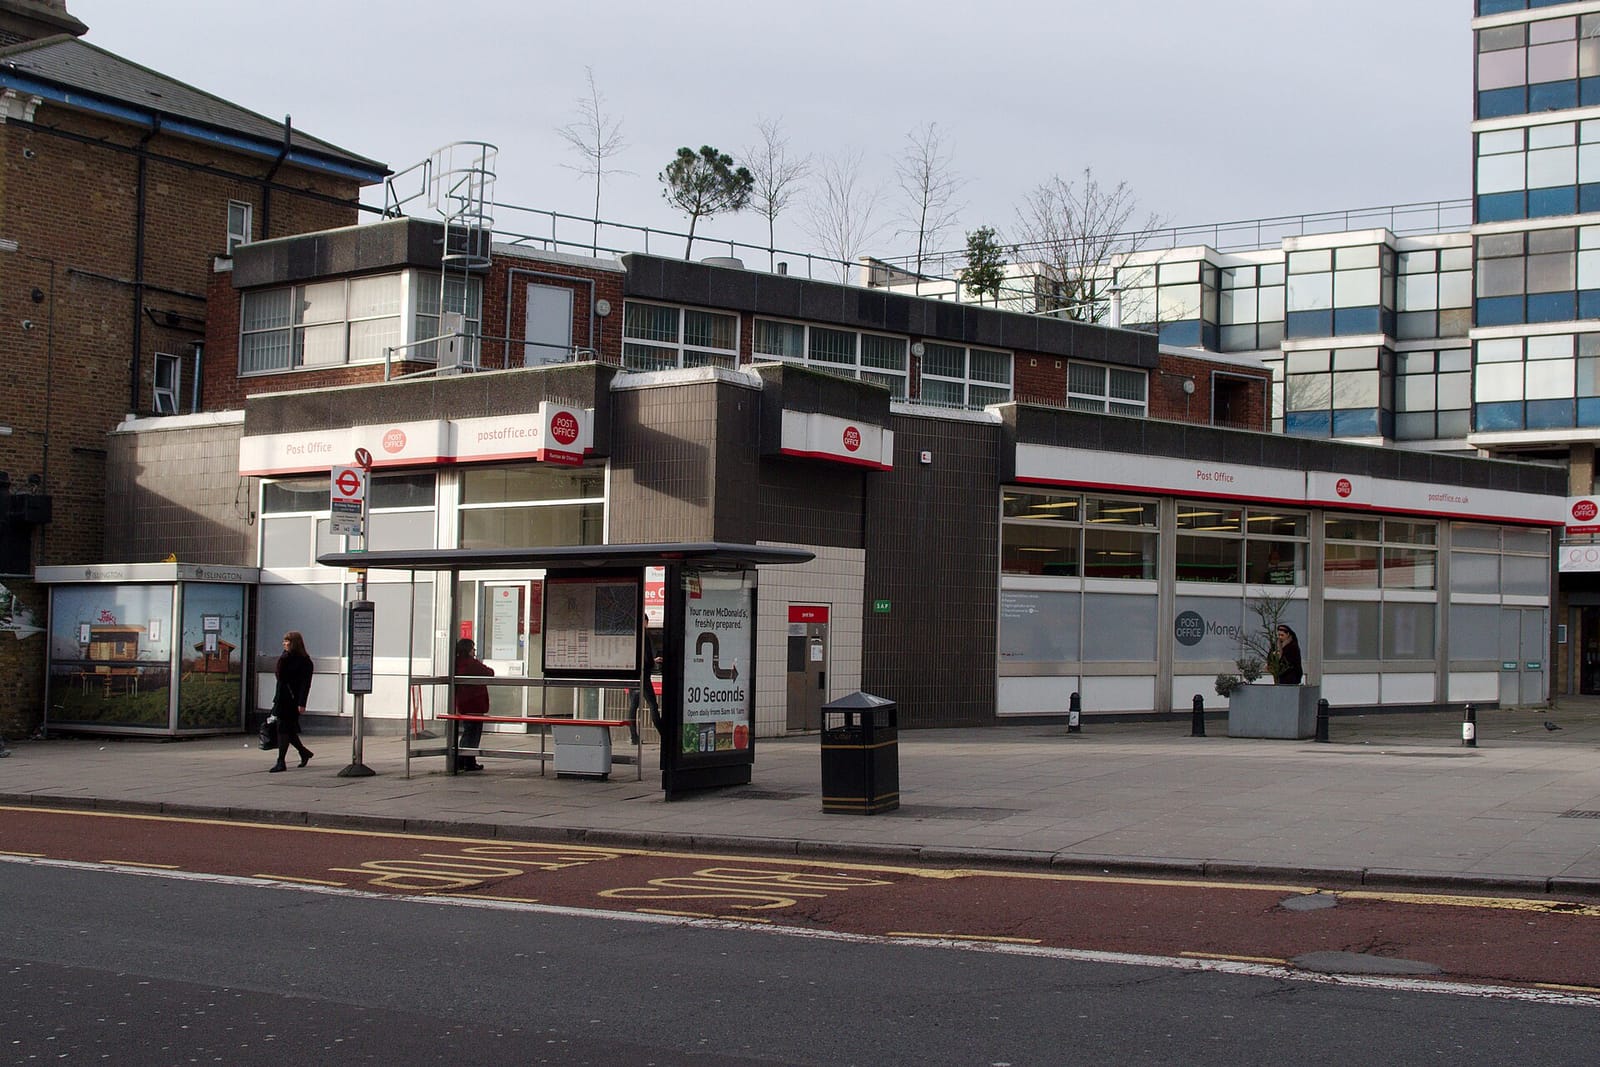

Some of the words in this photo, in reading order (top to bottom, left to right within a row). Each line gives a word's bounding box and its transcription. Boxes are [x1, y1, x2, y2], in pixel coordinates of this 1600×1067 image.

[556, 418, 574, 428] POST
[552, 427, 576, 438] OFFICE
[384, 440, 404, 448] OFFICE
[844, 438, 859, 446] OFFICE
[286, 444, 304, 455] Post
[308, 442, 332, 453] Office
[358, 450, 368, 464] V
[1197, 470, 1212, 480] Post
[1214, 472, 1234, 483] Office
[1428, 493, 1469, 504] postoffice.co.uk
[91, 570, 123, 578] ISLINGTON
[204, 572, 242, 580] ISLINGTON
[689, 606, 702, 616] Your
[695, 619, 714, 630] freshly
[1180, 618, 1199, 627] POST
[1206, 620, 1240, 640] Money
[1176, 628, 1201, 637] OFFICE
[688, 687, 701, 703] 30
[703, 686, 744, 703] Seconds
[700, 709, 709, 717] daily
[328, 846, 623, 890] STOP
[597, 866, 894, 909] BUS
